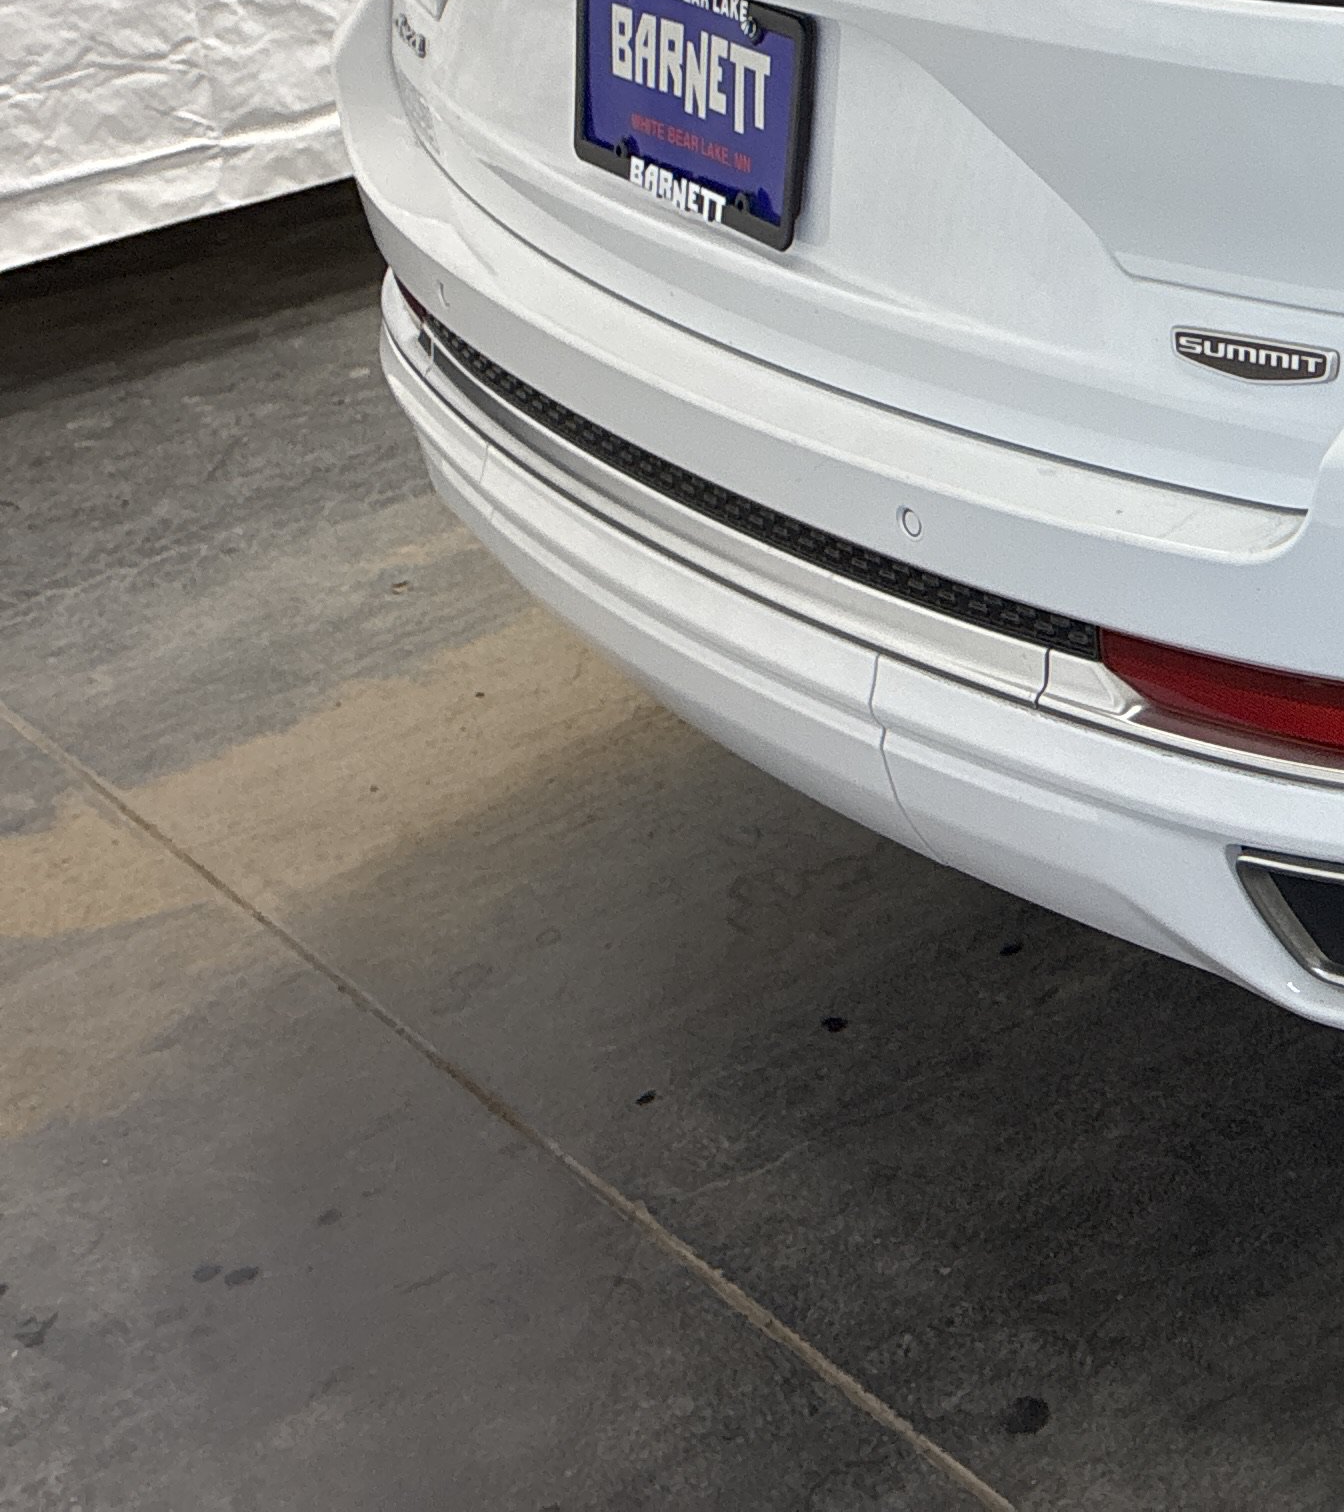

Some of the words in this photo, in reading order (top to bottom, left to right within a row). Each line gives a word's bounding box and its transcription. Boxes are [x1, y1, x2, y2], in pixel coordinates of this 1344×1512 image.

[612, 2, 771, 135] BARNETT
[630, 112, 665, 137] WHITE
[667, 123, 699, 152] BEAR
[630, 155, 726, 224] BARNETT
[1178, 336, 1323, 373] SUMMIT
